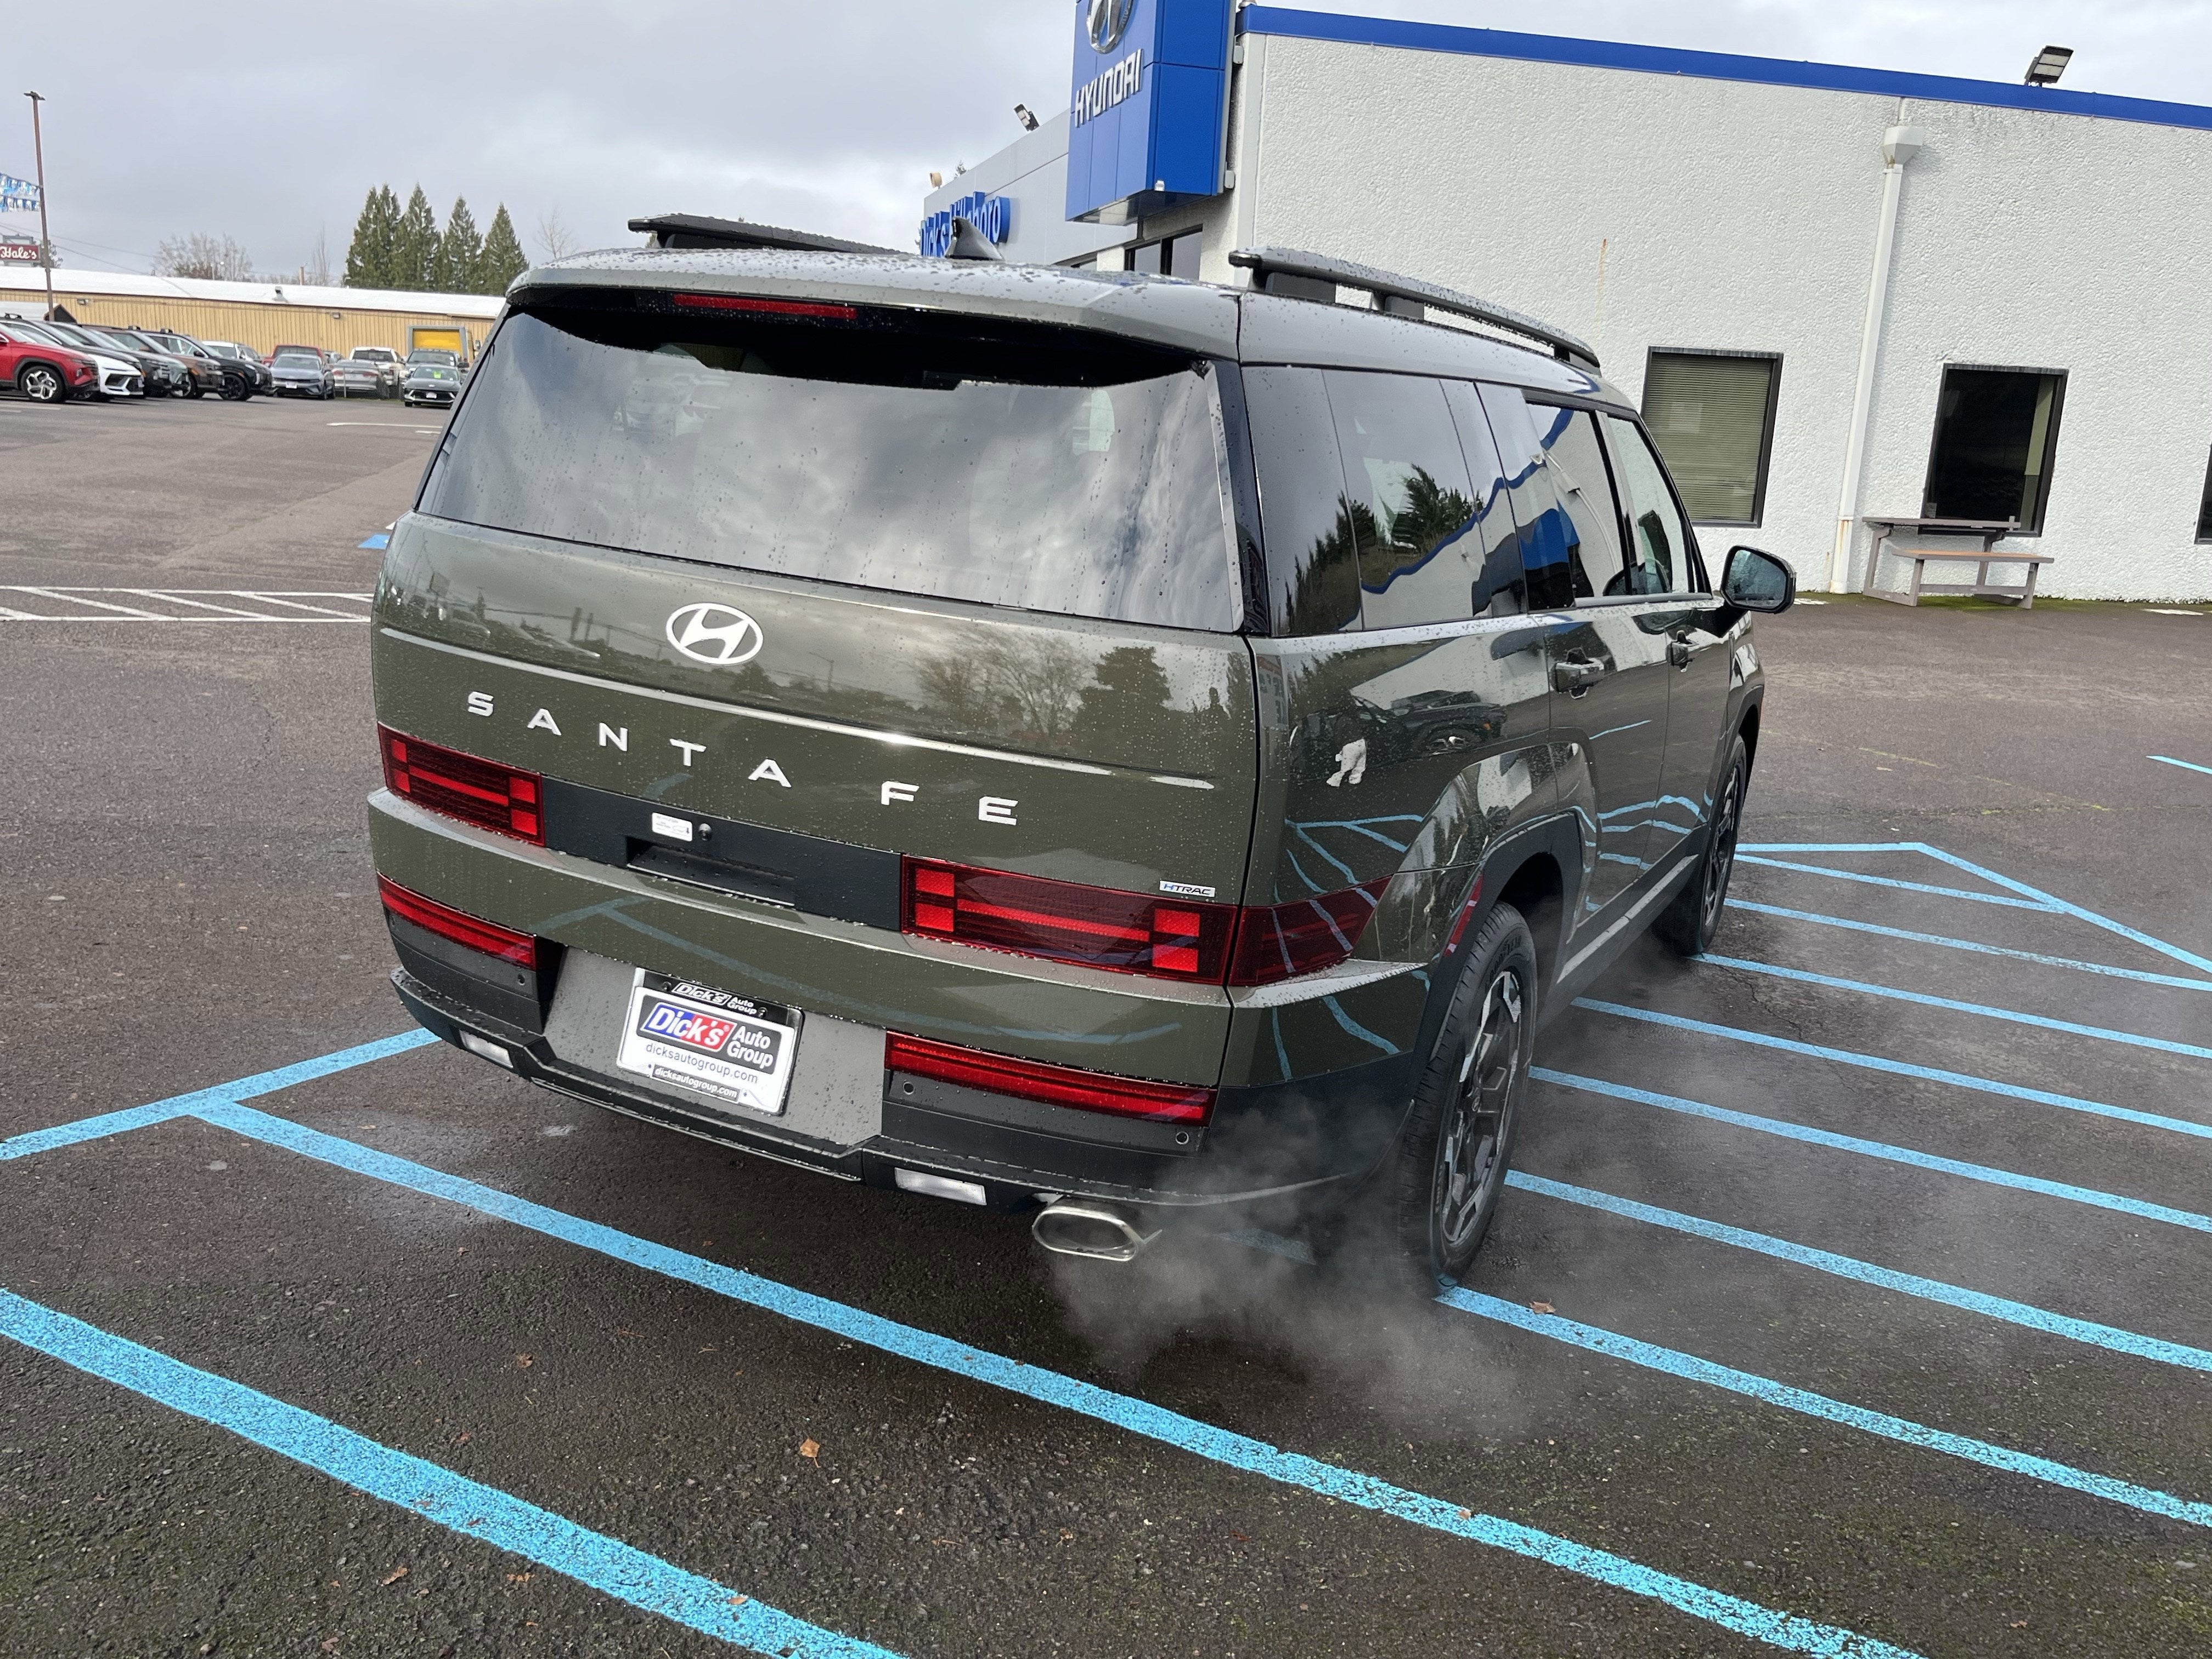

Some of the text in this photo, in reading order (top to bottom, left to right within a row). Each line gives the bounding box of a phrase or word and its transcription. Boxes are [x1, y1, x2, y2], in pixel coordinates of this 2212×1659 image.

[1074, 49, 1142, 127] HYUNDAI
[0, 246, 37, 259] Hale's
[467, 691, 1019, 826] SANTA FE
[1164, 883, 1211, 895] HTRAC
[676, 984, 726, 1003] Dick's
[730, 997, 754, 1007] Auto
[727, 1001, 757, 1015] Group
[648, 1007, 725, 1046] Dick's
[732, 1025, 771, 1049] Auto
[646, 1043, 758, 1084] dicksautogroup.com
[726, 1040, 774, 1069] Group
[654, 1067, 737, 1098] dicksautogroup.com
